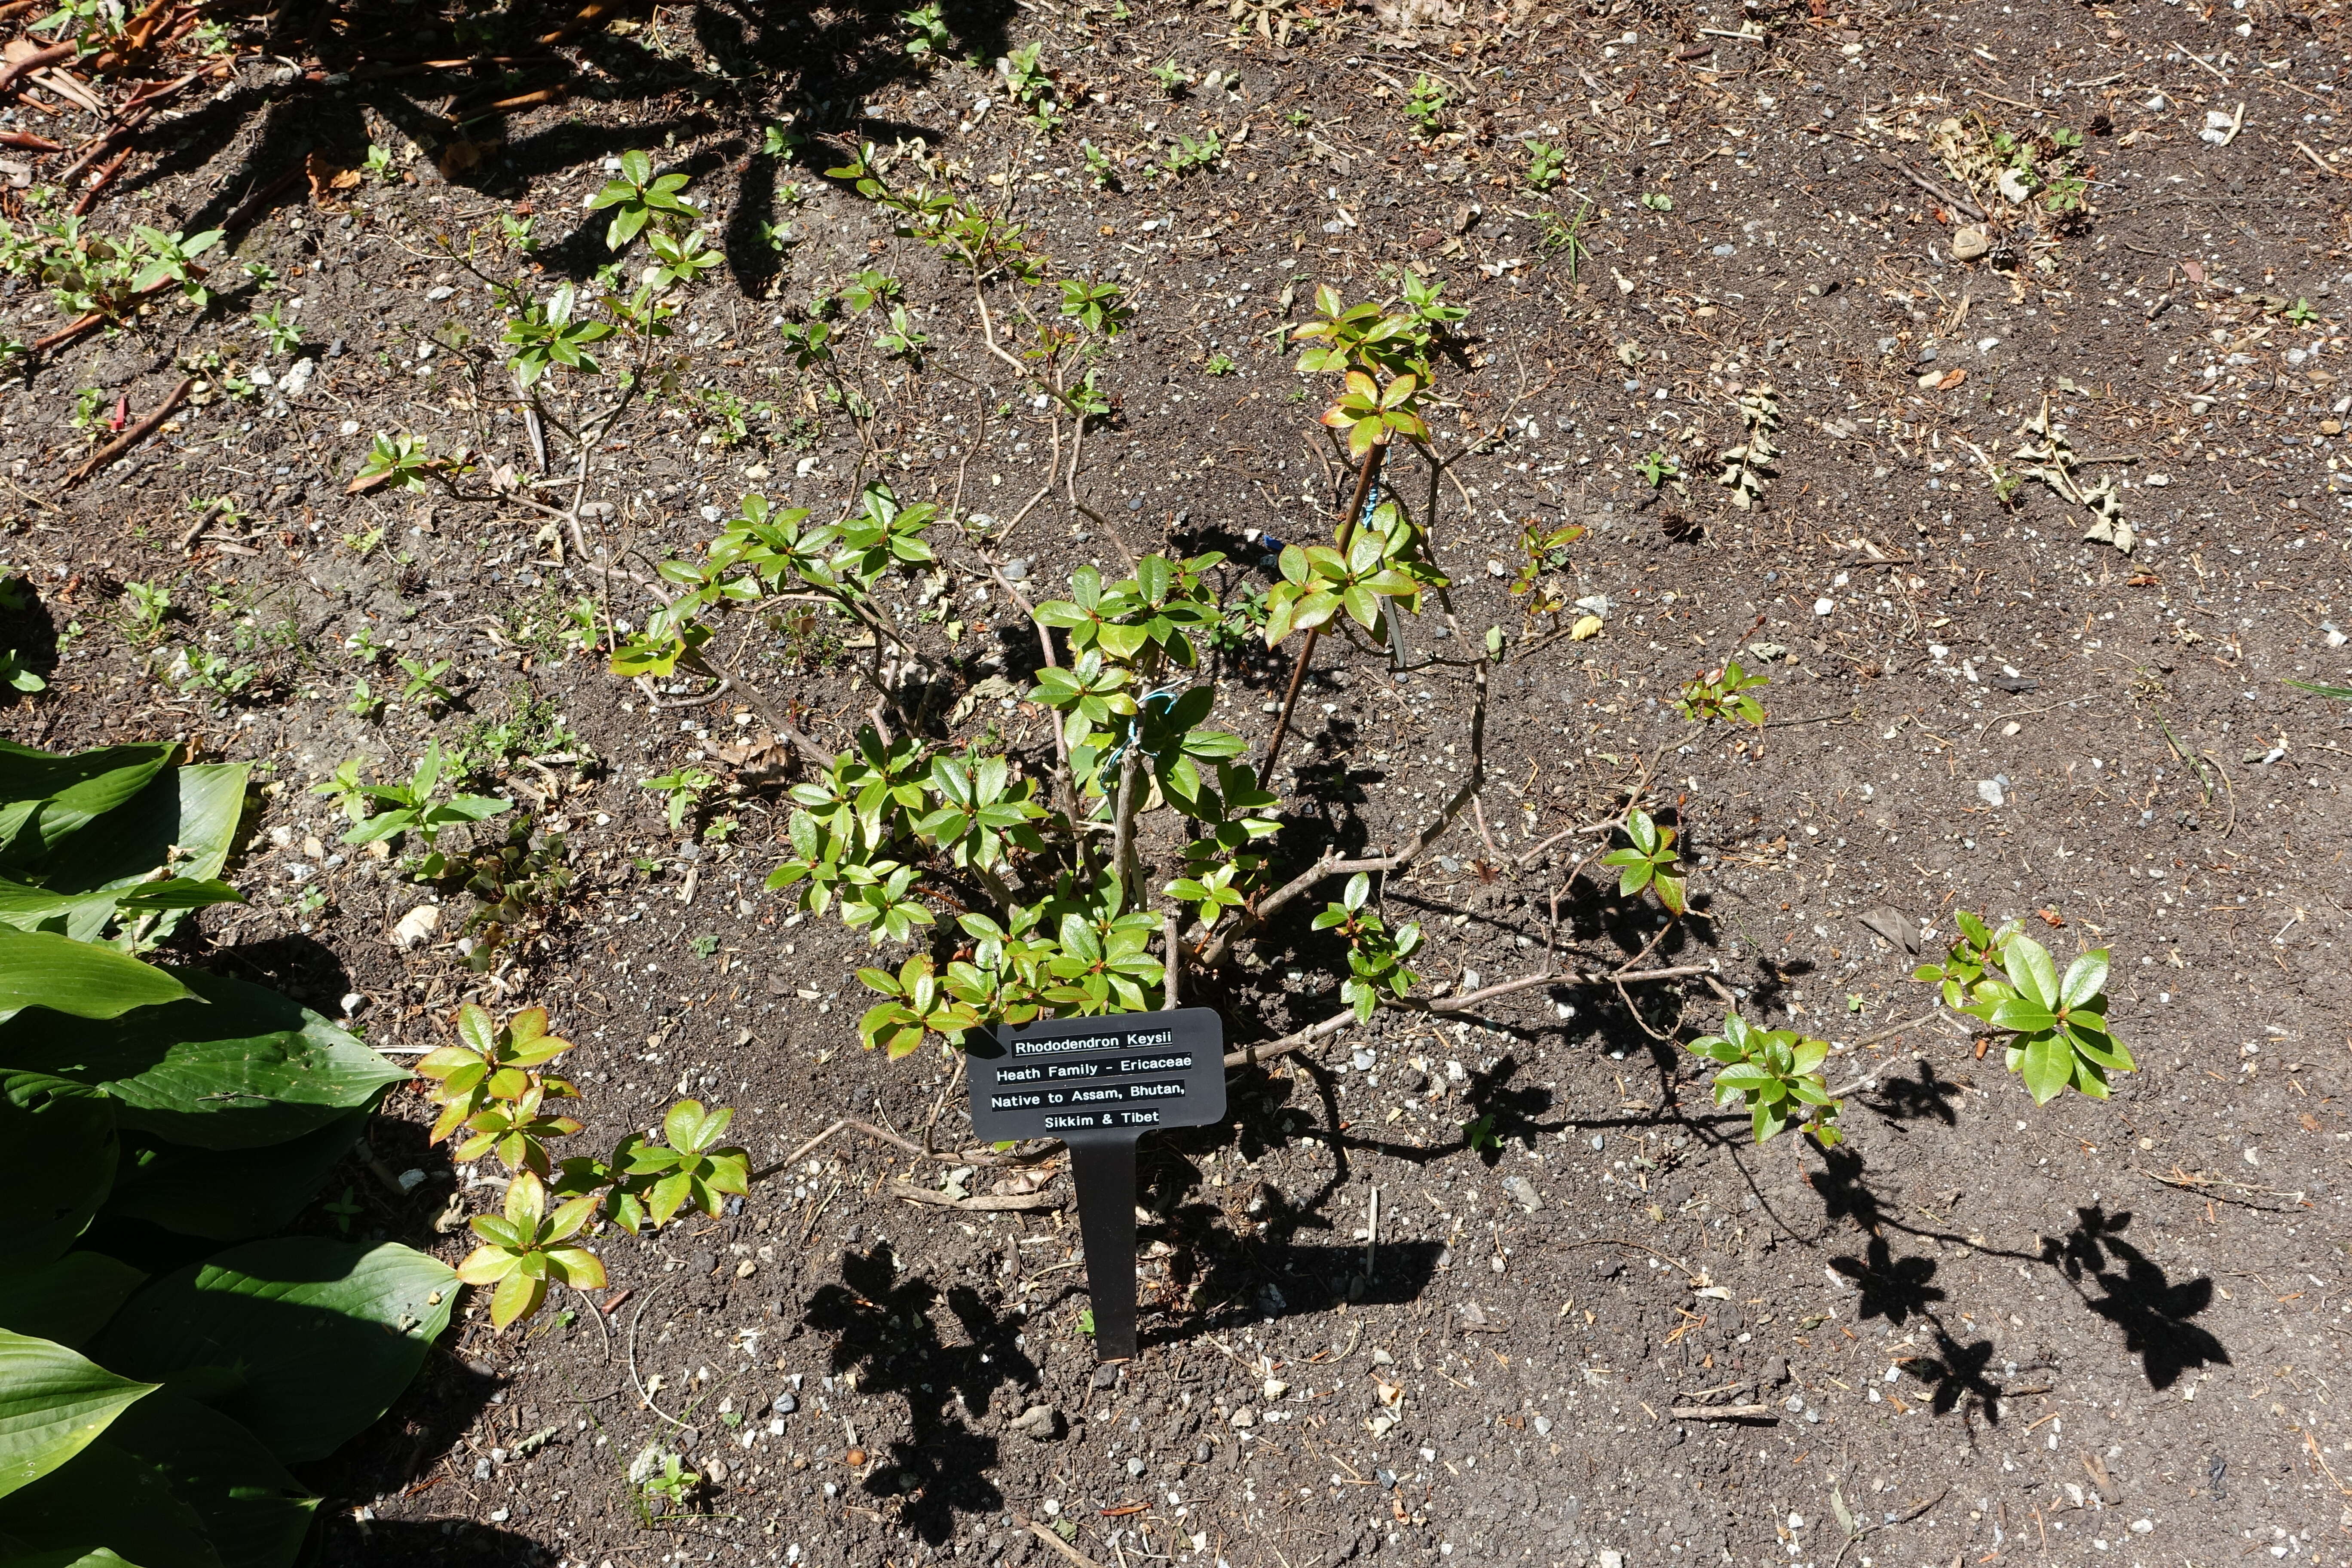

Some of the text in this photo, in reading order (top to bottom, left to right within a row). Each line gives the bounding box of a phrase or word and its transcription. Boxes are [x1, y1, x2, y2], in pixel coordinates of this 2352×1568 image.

[1016, 1032, 1172, 1054] Rhododendron Keysii
[996, 1068, 1040, 1081] Heath
[1049, 1064, 1097, 1077] Family
[1121, 1057, 1191, 1071] Ericaceae
[992, 1084, 1184, 1108] Native to Assam, Bhutan,
[1045, 1112, 1159, 1128] Sikkim & Tibet
